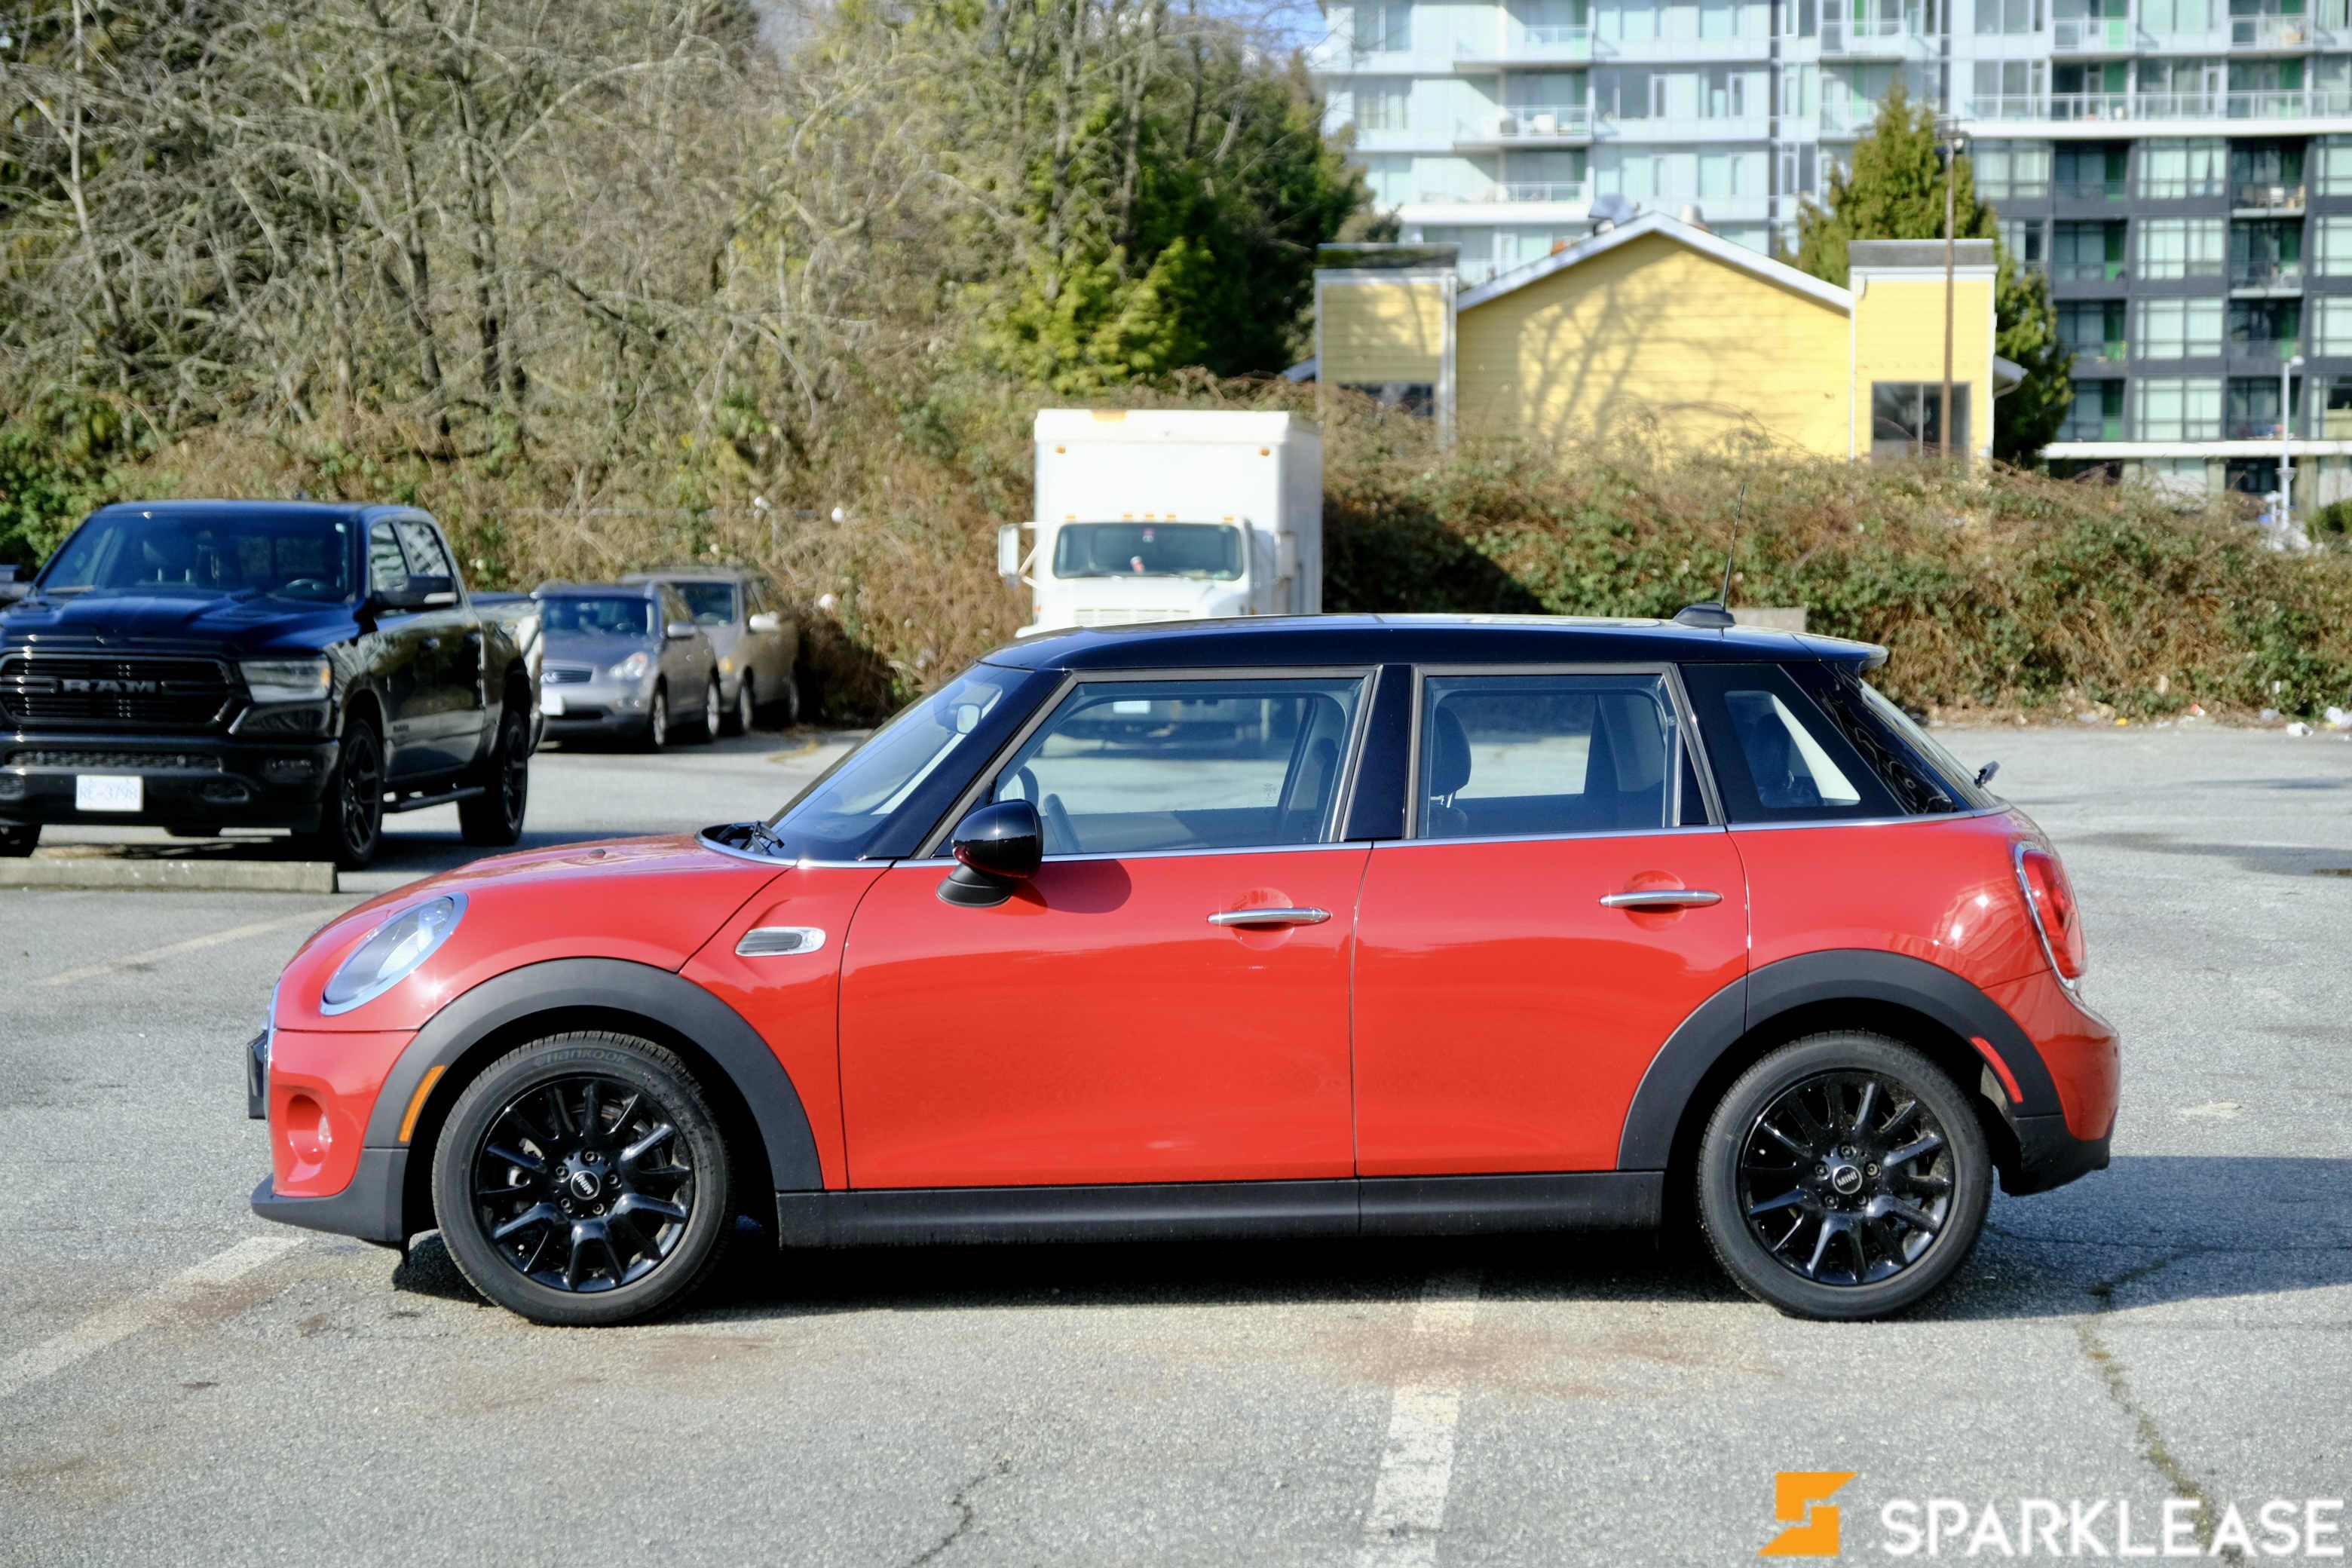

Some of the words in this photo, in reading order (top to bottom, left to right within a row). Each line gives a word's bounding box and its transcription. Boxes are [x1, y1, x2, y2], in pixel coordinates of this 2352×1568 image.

[63, 679, 156, 692] RAM
[576, 1174, 594, 1195] MINI
[1836, 1171, 1857, 1187] MINI
